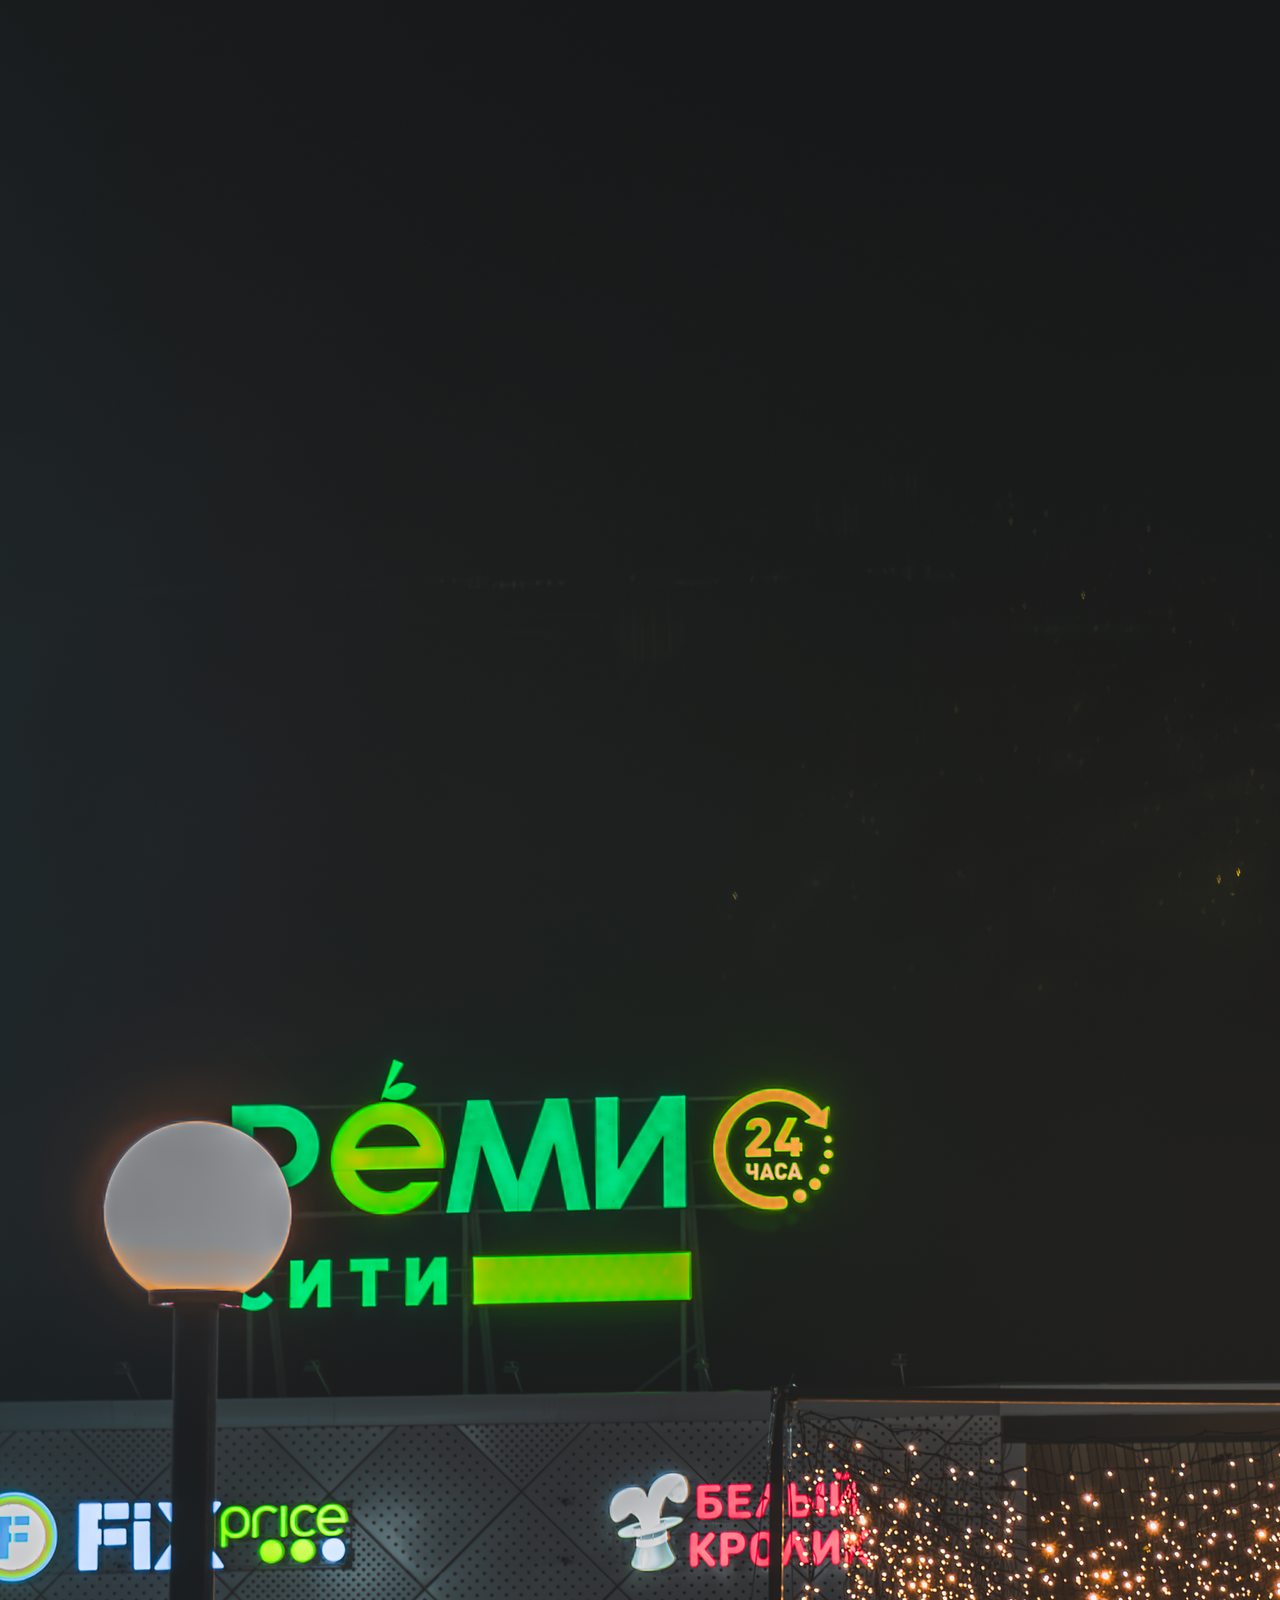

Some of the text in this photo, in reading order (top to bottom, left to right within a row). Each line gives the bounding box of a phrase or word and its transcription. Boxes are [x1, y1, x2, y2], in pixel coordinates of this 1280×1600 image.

[744, 1117, 803, 1158] 24
[745, 1160, 803, 1181] ЧАСА
[220, 1504, 348, 1548] price
[689, 1529, 870, 1568] КРОЛИК
